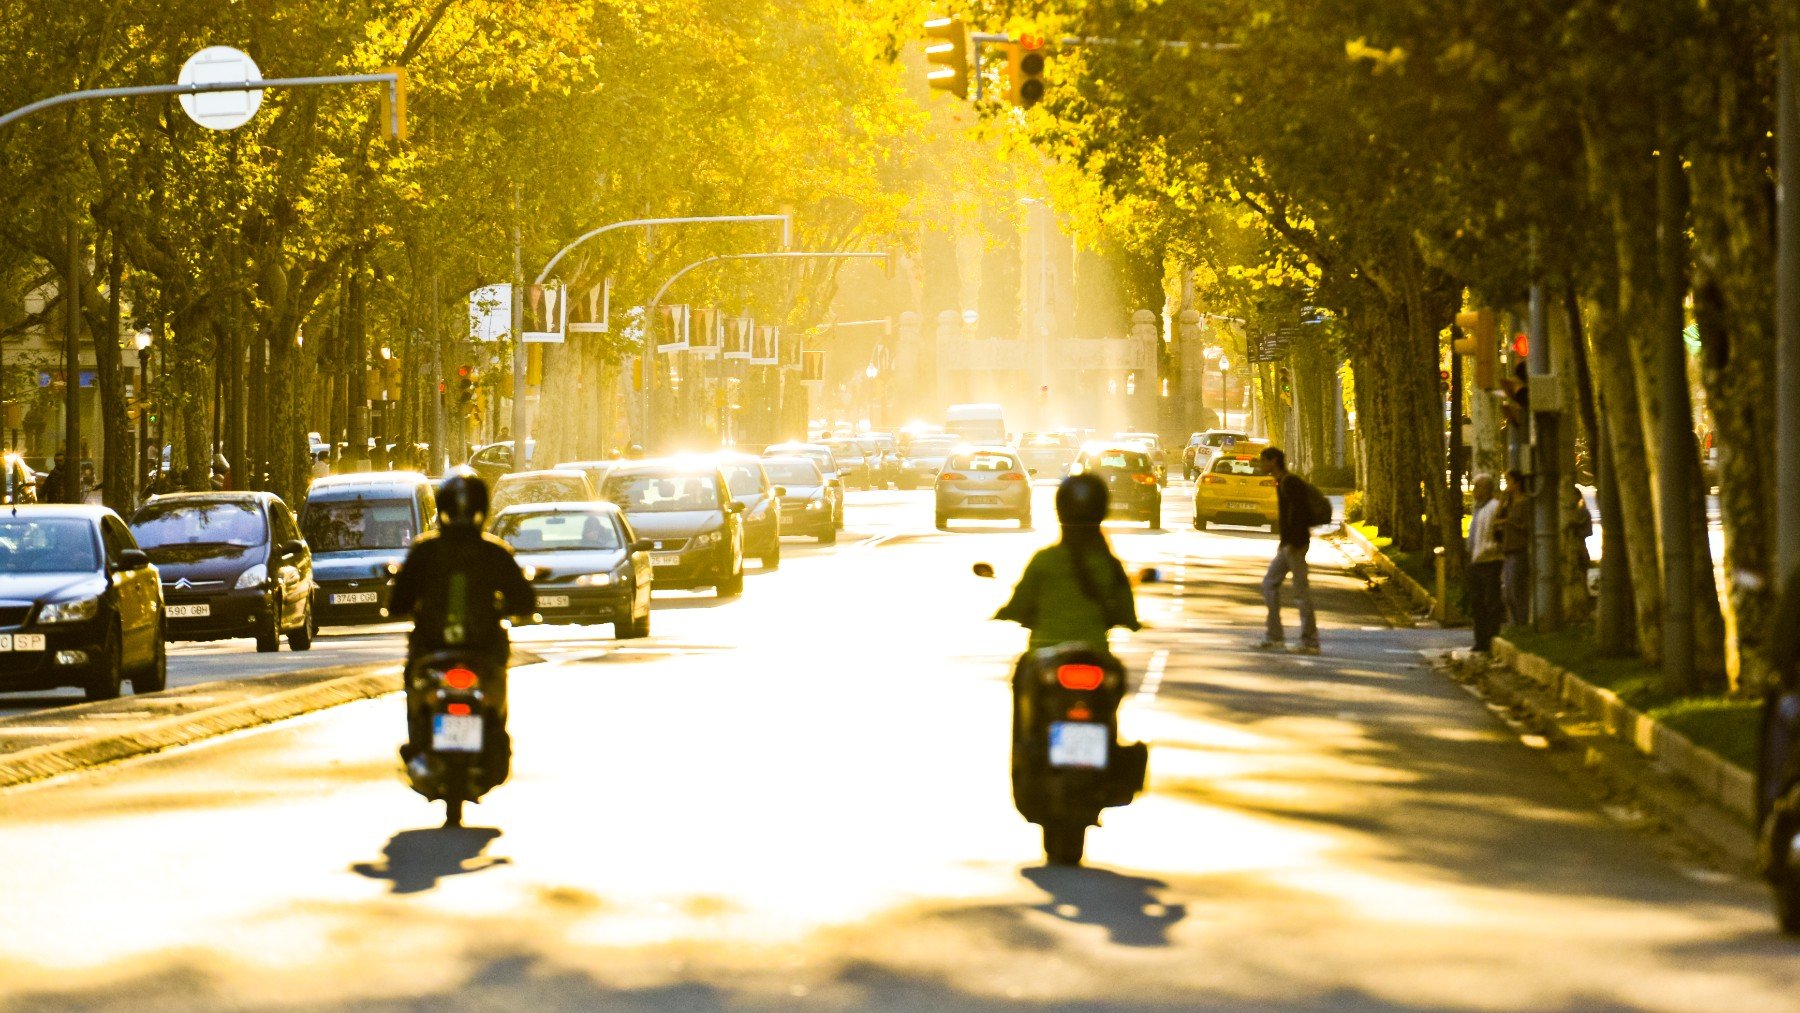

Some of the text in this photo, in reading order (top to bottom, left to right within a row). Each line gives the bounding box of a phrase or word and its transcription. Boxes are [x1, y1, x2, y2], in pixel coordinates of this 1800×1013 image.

[336, 594, 357, 604] 3749
[168, 605, 208, 616] 590 GBH
